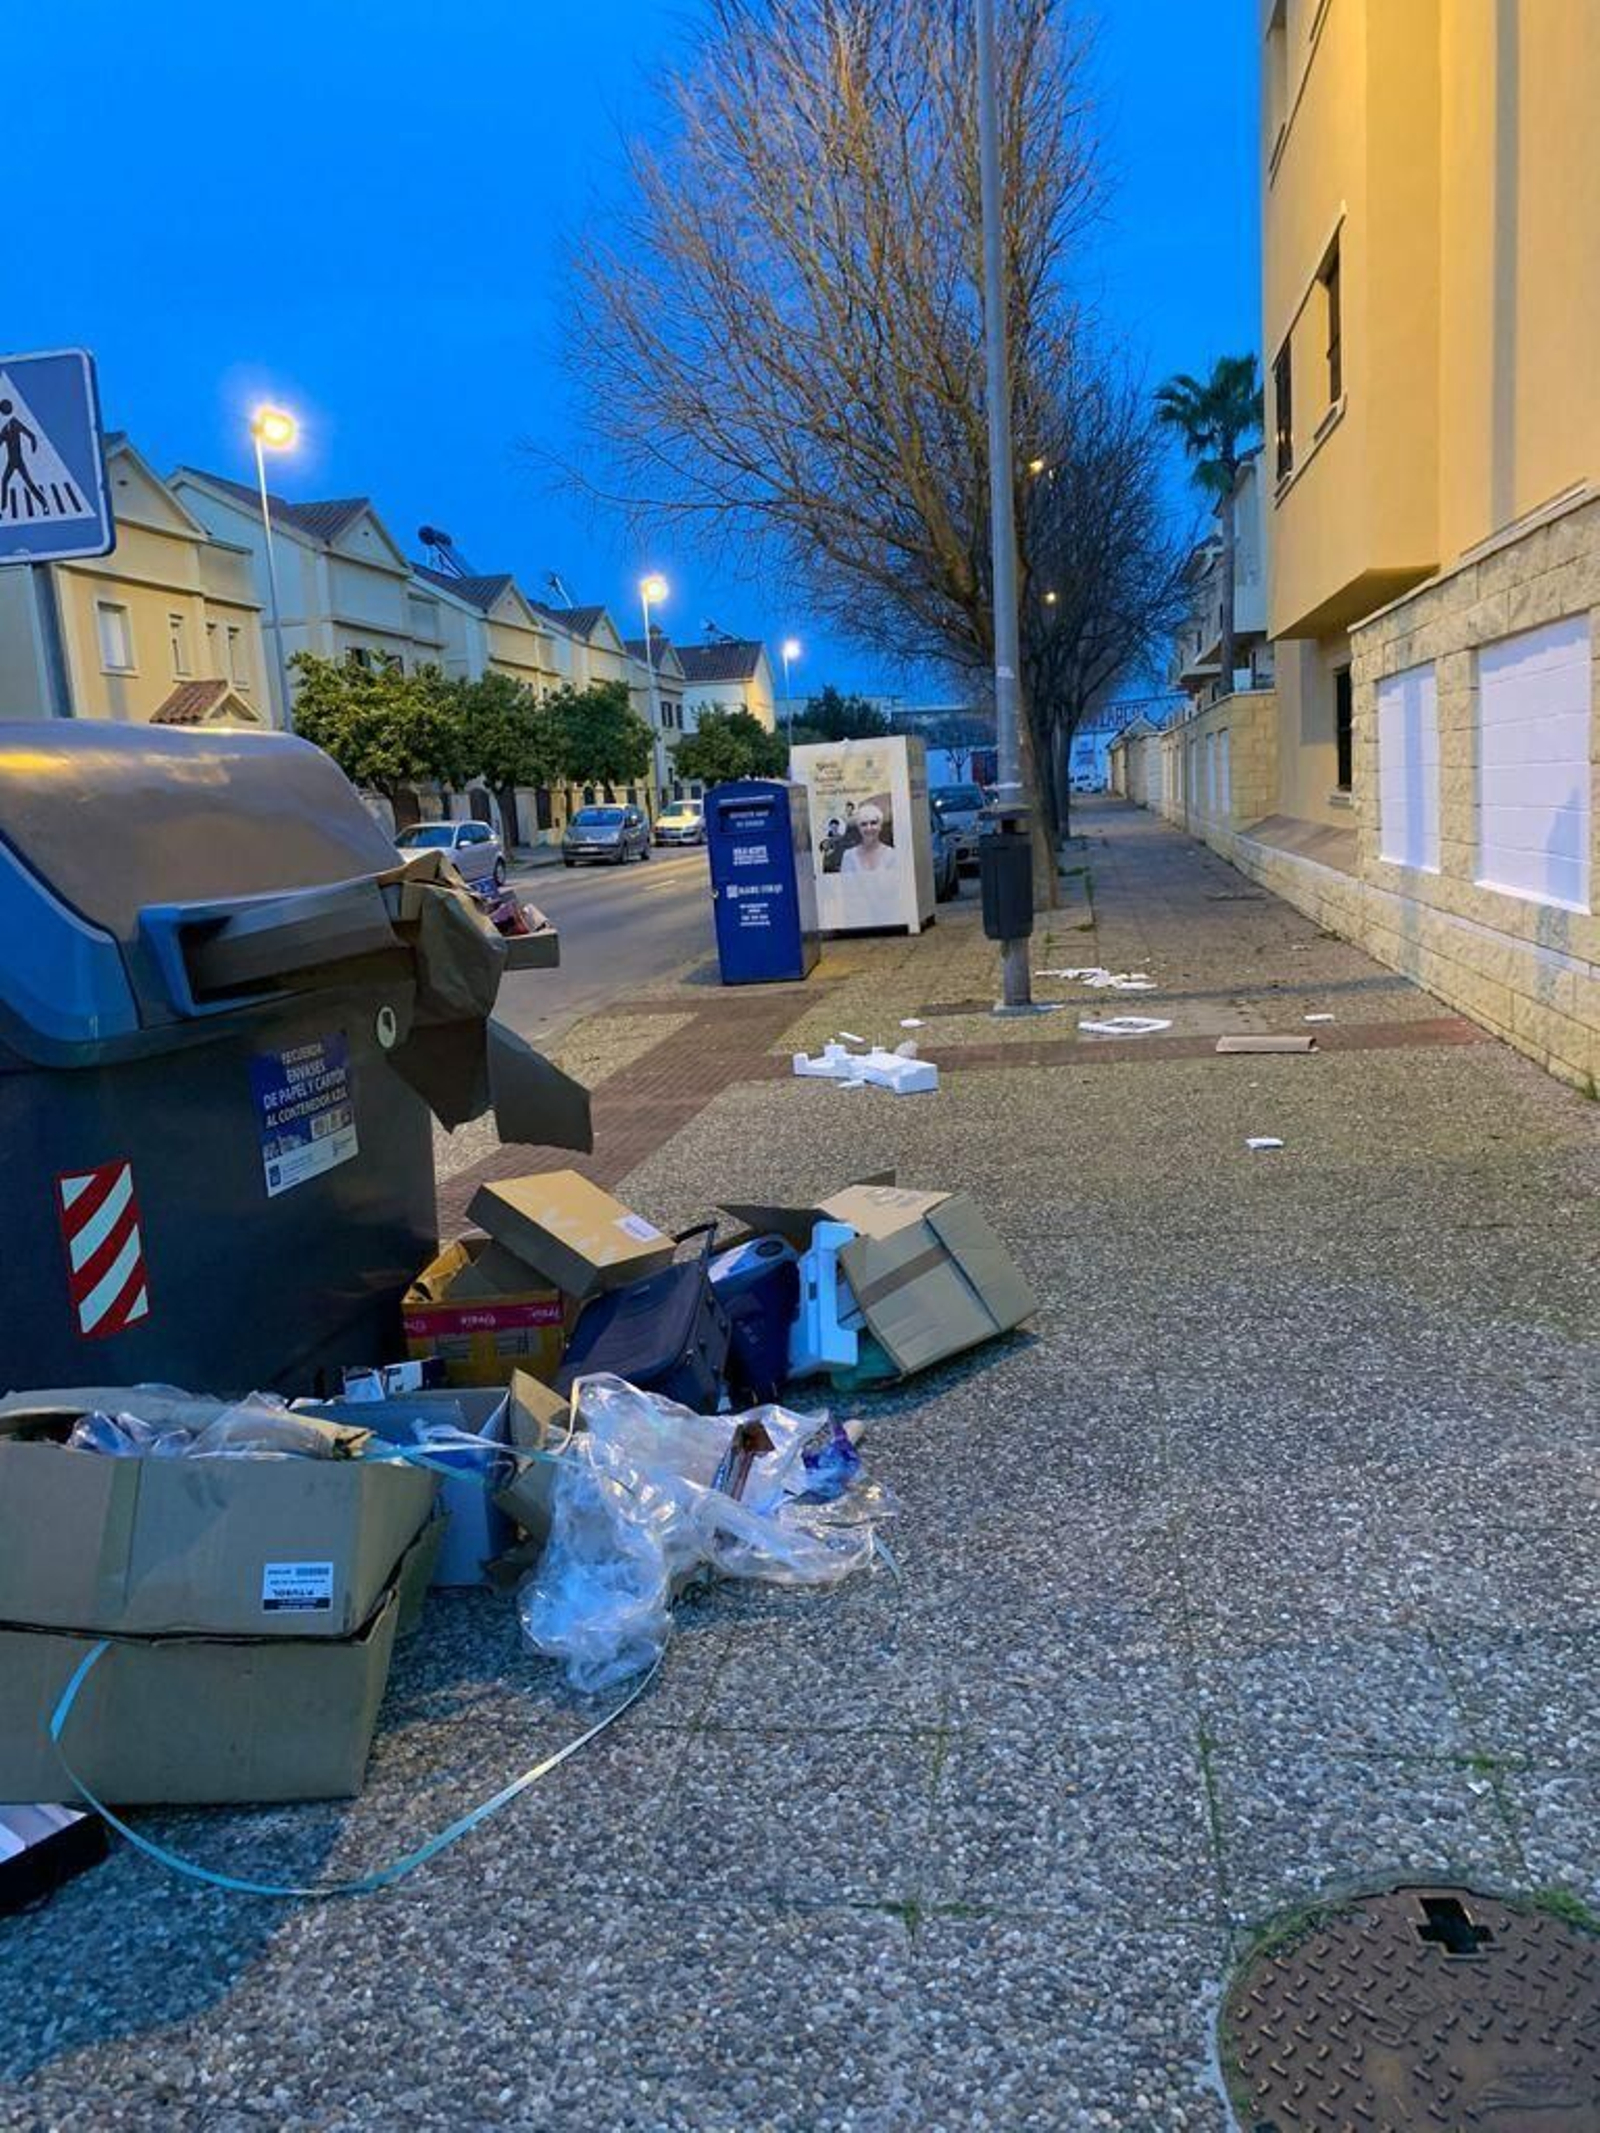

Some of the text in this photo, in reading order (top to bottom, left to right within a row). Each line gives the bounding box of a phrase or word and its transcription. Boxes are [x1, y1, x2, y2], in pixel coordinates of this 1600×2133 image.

[286, 1059, 325, 1084] ENVASES
[263, 1092, 278, 1110] DE
[279, 1081, 307, 1105] PAPEL
[266, 1112, 278, 1129] AL
